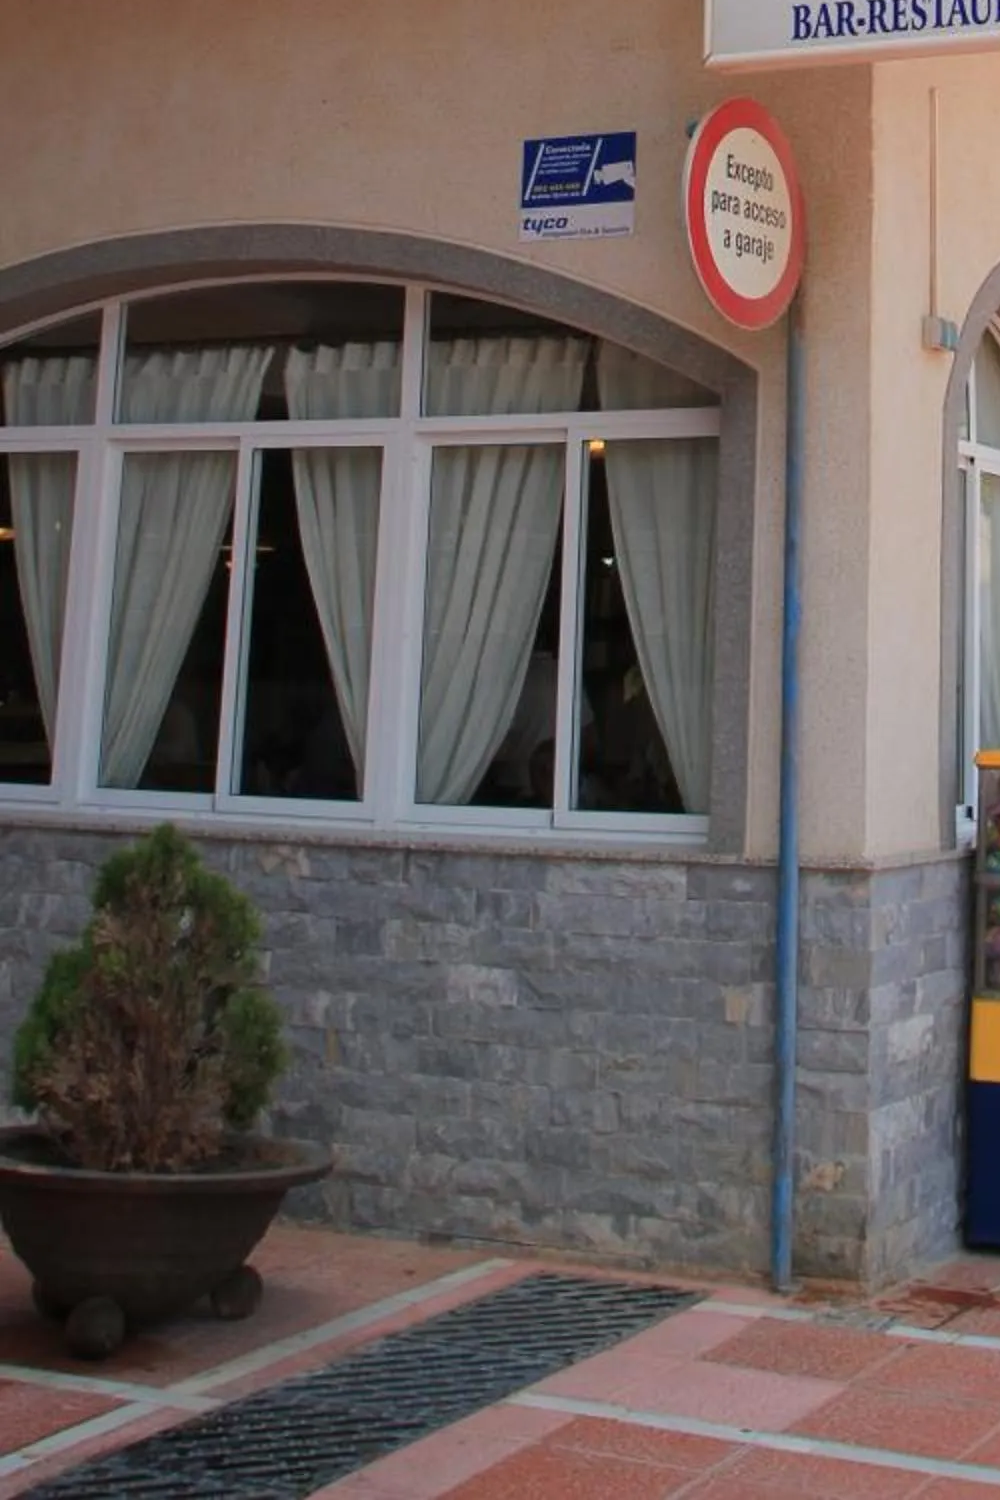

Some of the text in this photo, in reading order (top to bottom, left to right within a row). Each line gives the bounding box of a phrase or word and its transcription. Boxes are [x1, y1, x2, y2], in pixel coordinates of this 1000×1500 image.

[726, 153, 773, 191] Excepto
[523, 217, 568, 233] tyco
[711, 190, 787, 229] para acceso
[723, 228, 775, 264] a garaje
